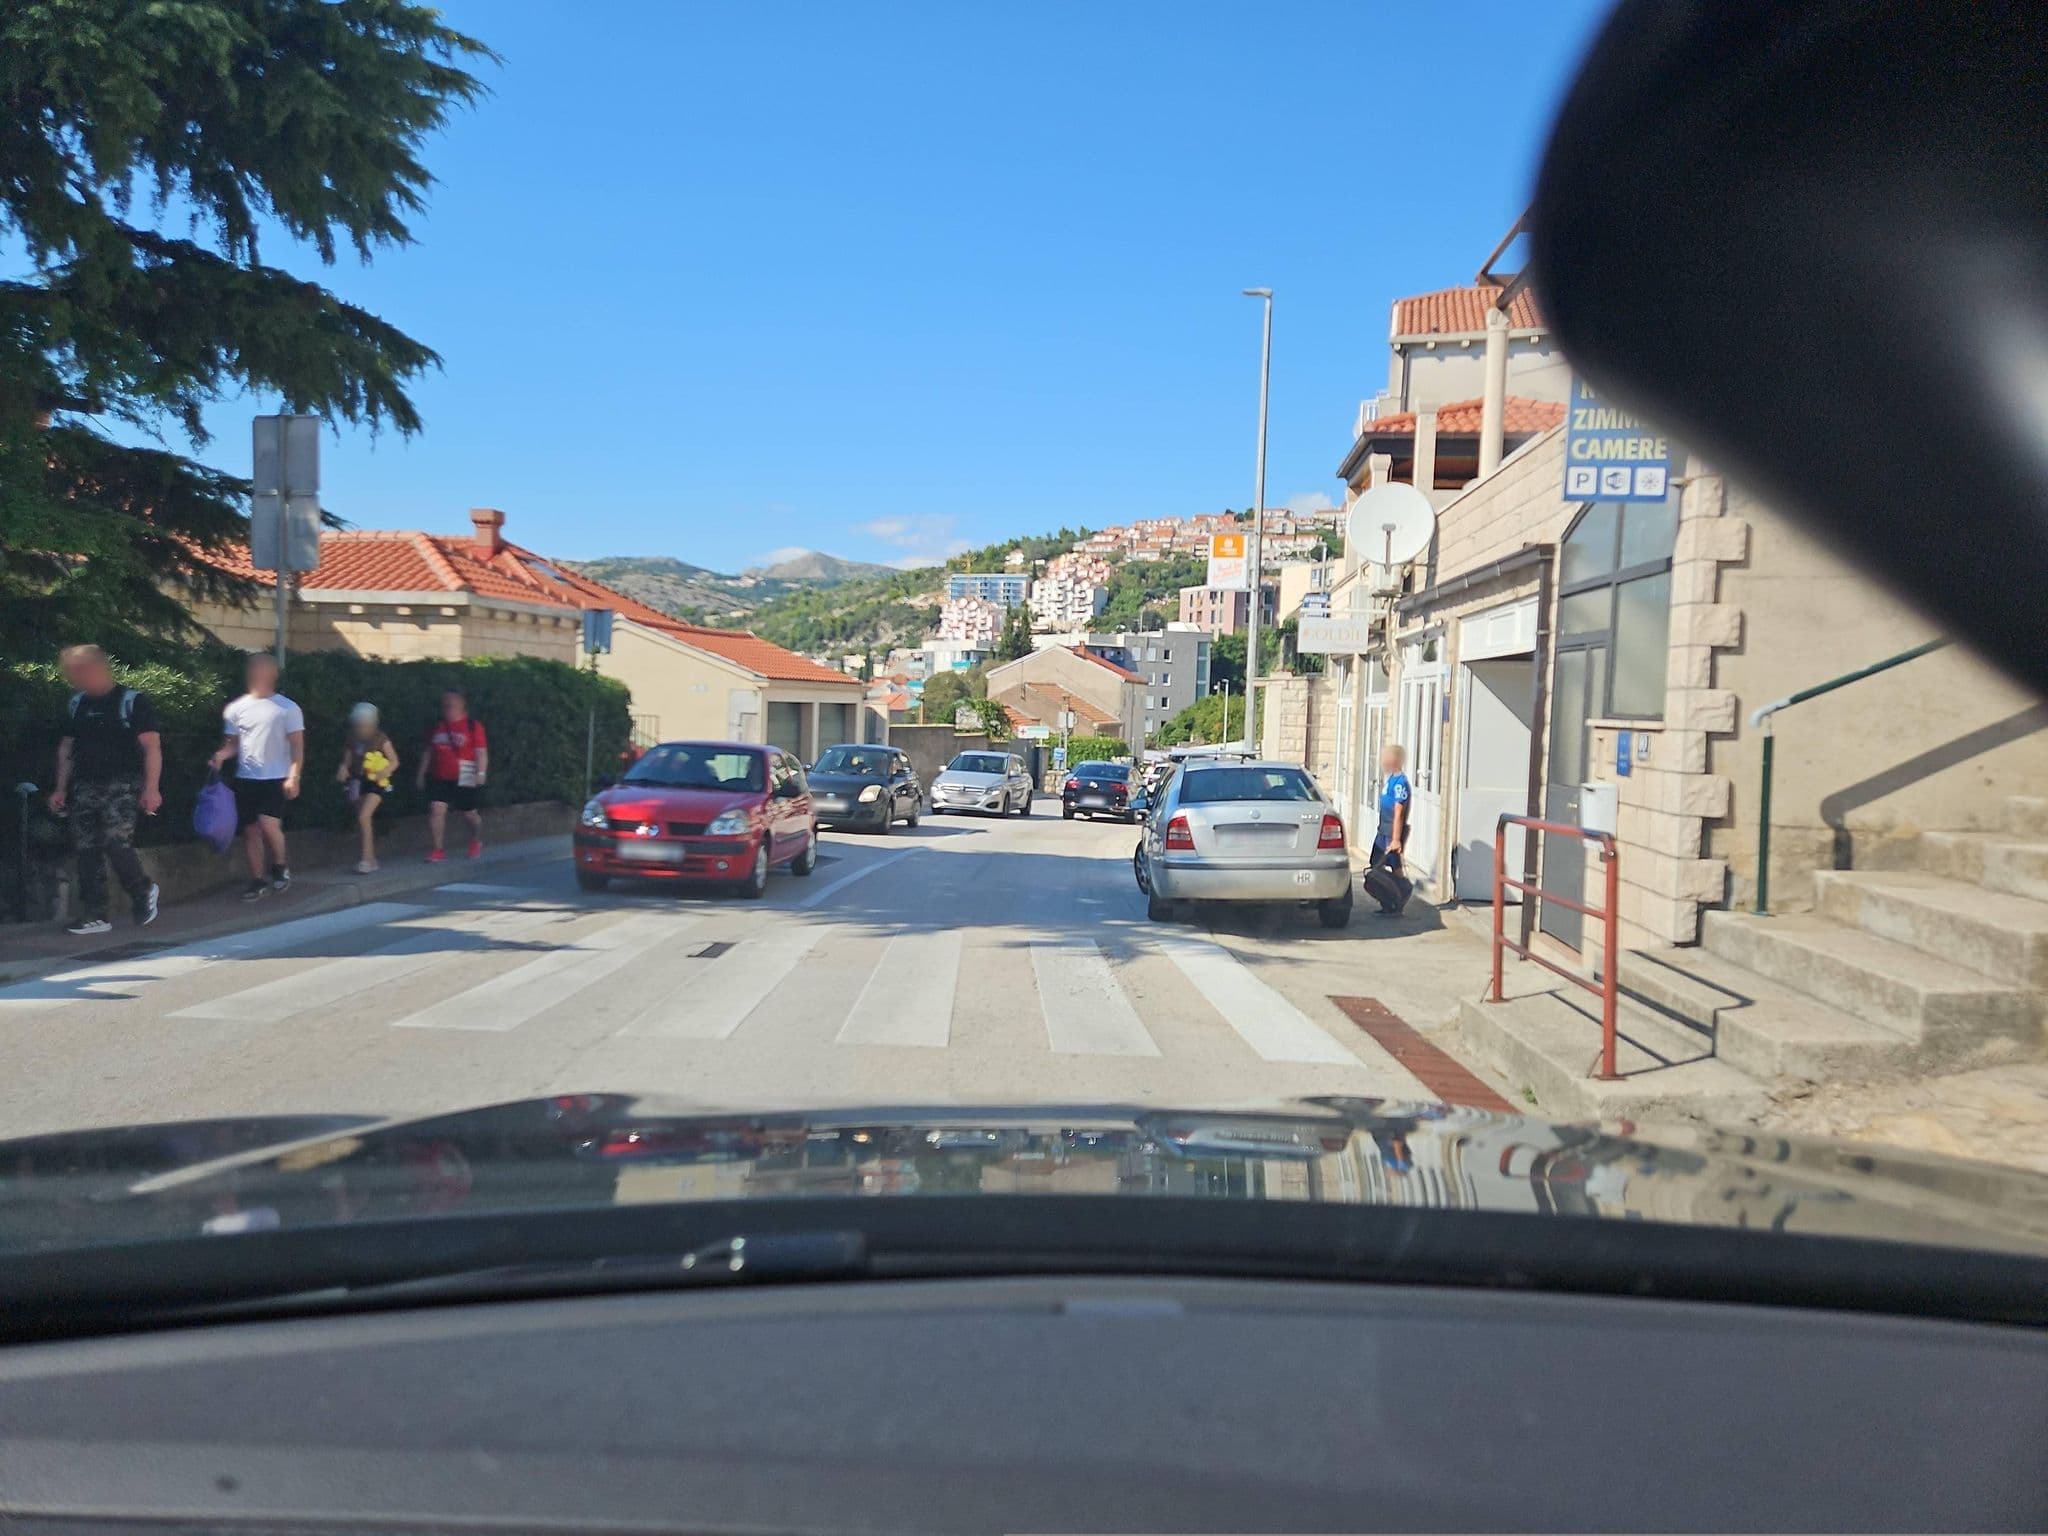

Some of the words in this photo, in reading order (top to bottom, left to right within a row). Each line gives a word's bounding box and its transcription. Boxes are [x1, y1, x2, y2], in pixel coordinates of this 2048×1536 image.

[1572, 438, 1667, 460] CAMERE
[1577, 473, 1589, 488] P
[1297, 872, 1311, 883] HR
